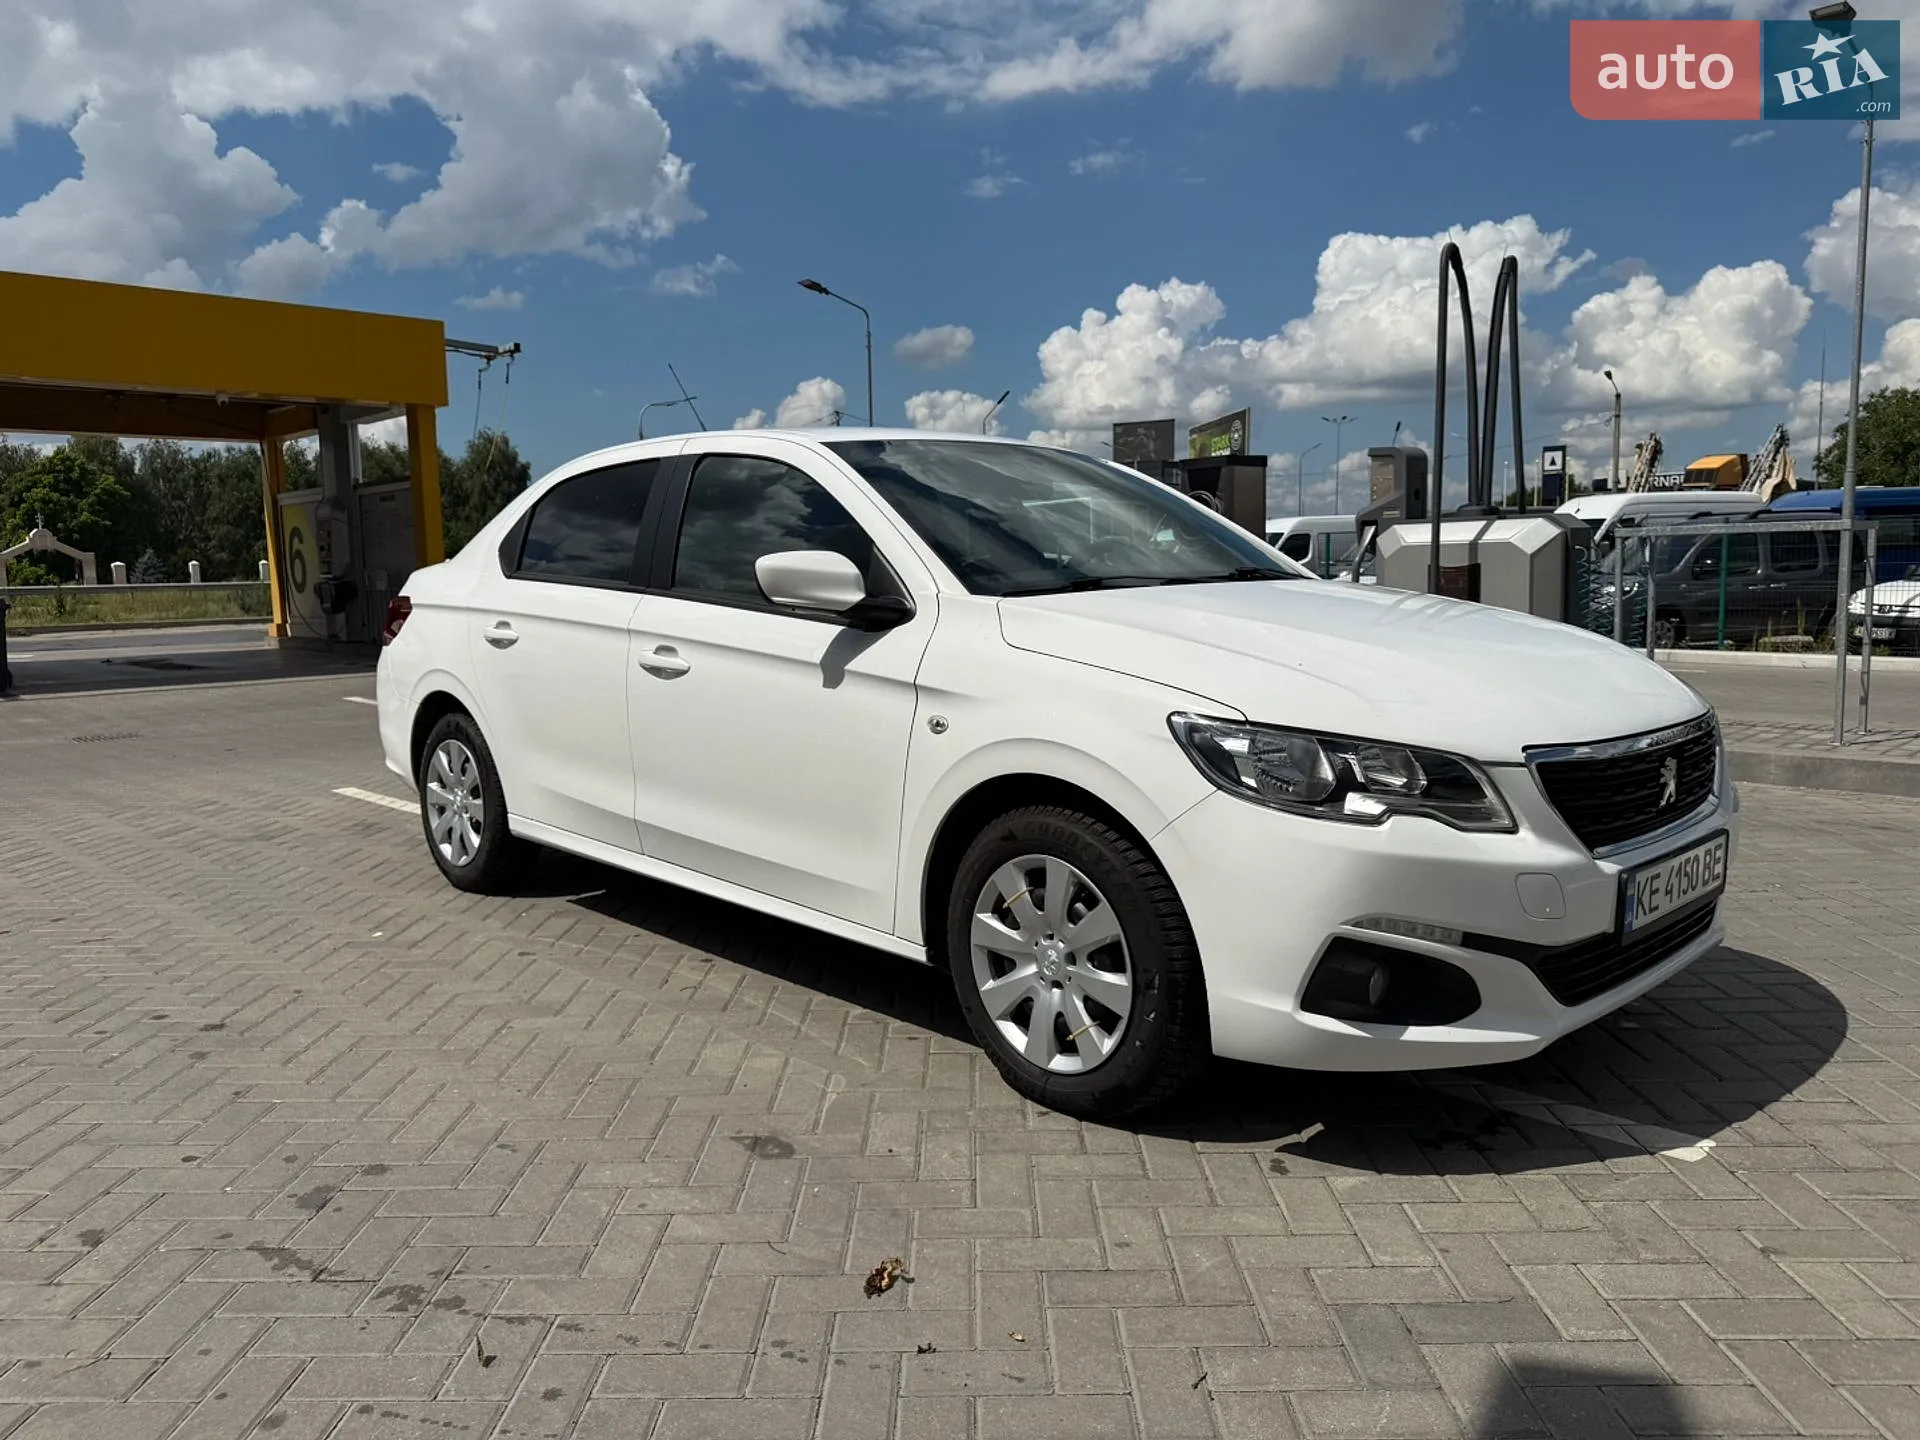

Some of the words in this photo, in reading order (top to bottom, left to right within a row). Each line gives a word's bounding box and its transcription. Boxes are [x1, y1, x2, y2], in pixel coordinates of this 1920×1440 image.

[289, 526, 307, 593] 6
[1635, 872, 1660, 920] KE
[1664, 854, 1700, 903] 4150
[1702, 843, 1723, 886] BE
